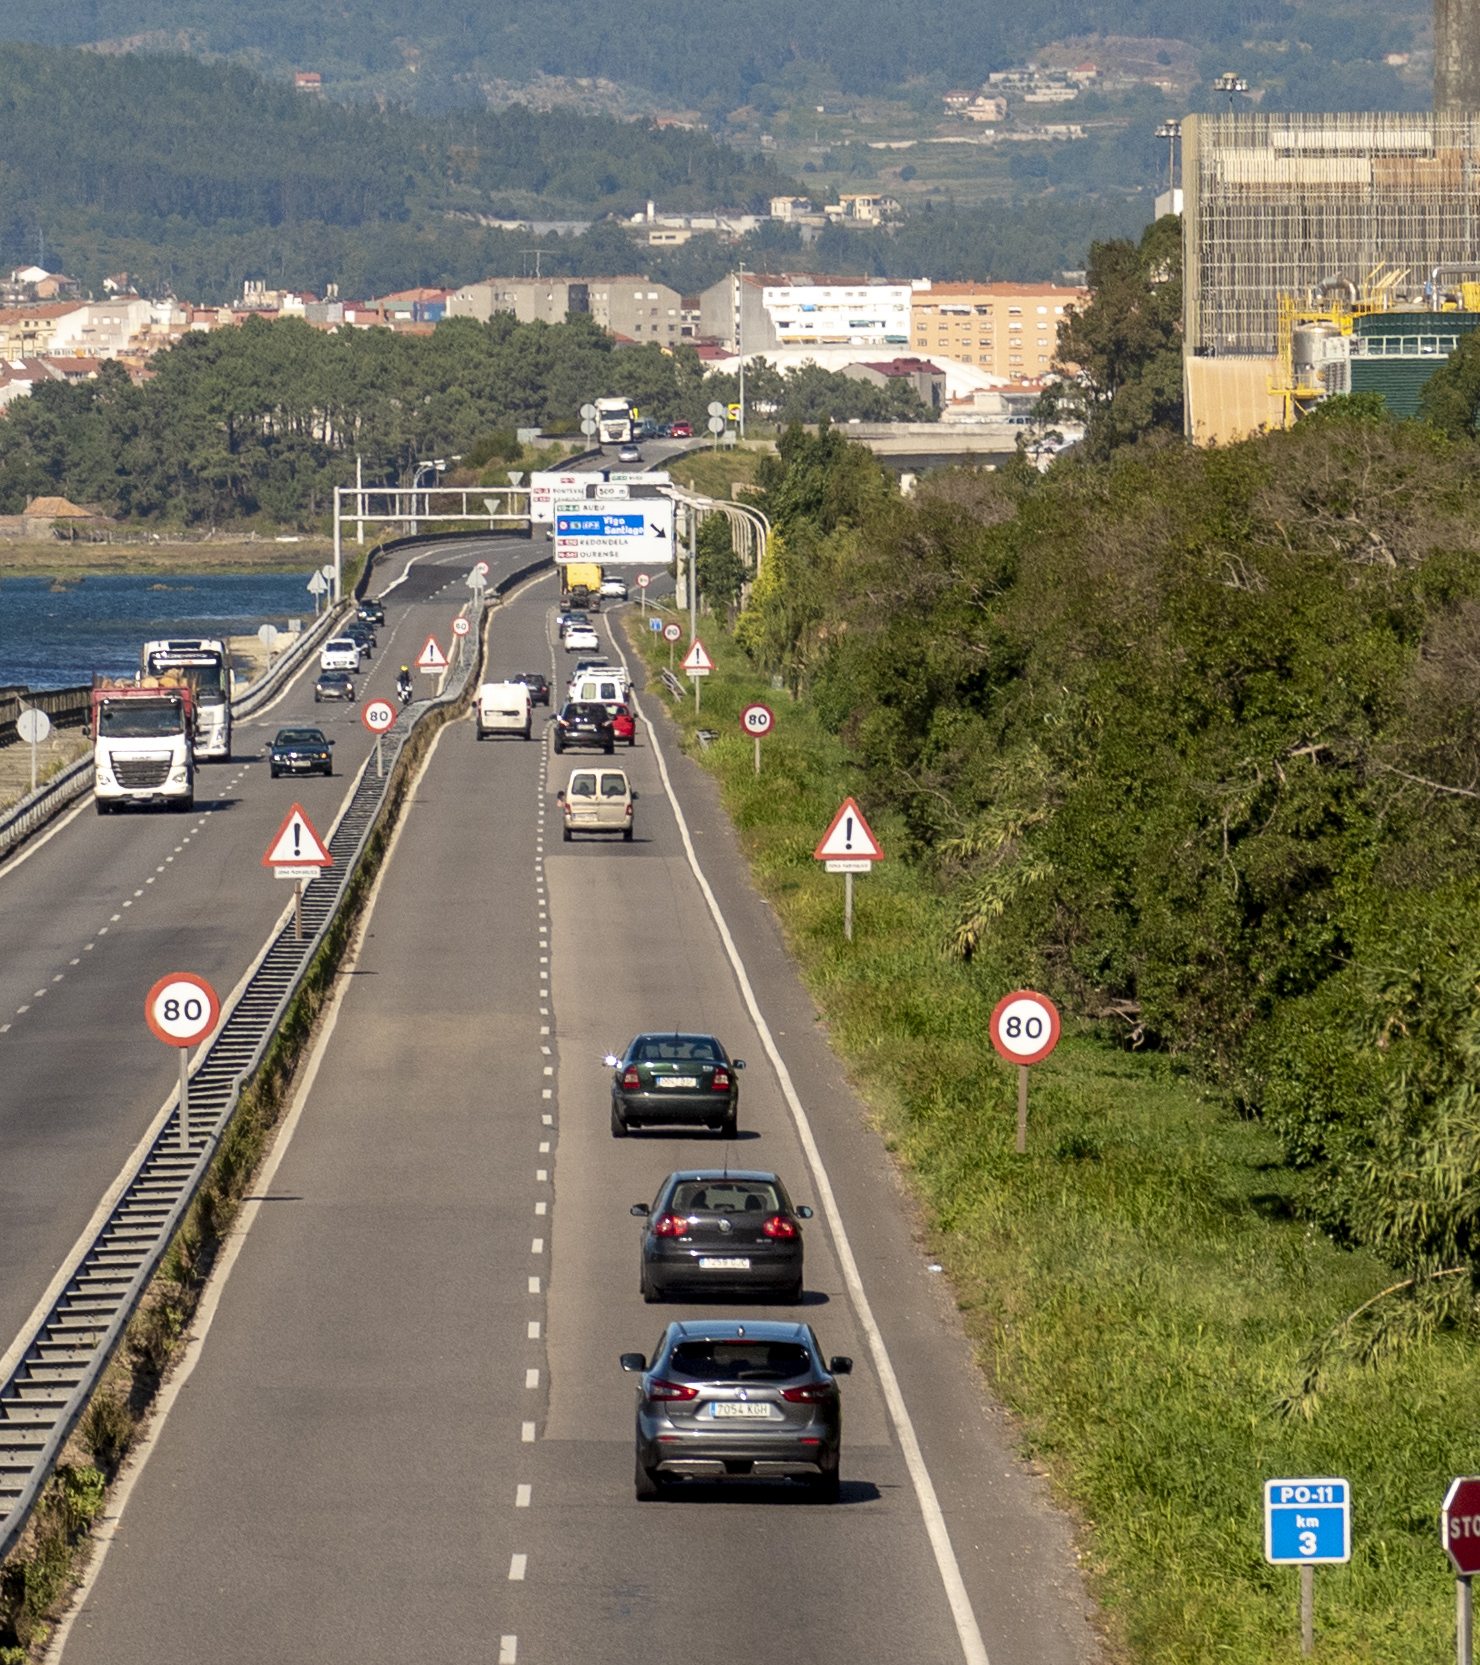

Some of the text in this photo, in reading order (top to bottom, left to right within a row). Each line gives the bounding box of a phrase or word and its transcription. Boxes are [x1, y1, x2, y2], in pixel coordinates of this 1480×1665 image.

[603, 516, 625, 526] Vigo
[603, 526, 644, 535] Santiago
[370, 711, 388, 721] 80
[749, 714, 767, 725] 80
[164, 999, 202, 1021] 80
[1006, 1016, 1043, 1039] 80
[717, 1404, 768, 1415] 7054 KGH
[1280, 1485, 1334, 1504] PO-11
[1295, 1514, 1319, 1528] km
[1298, 1531, 1317, 1555] 3
